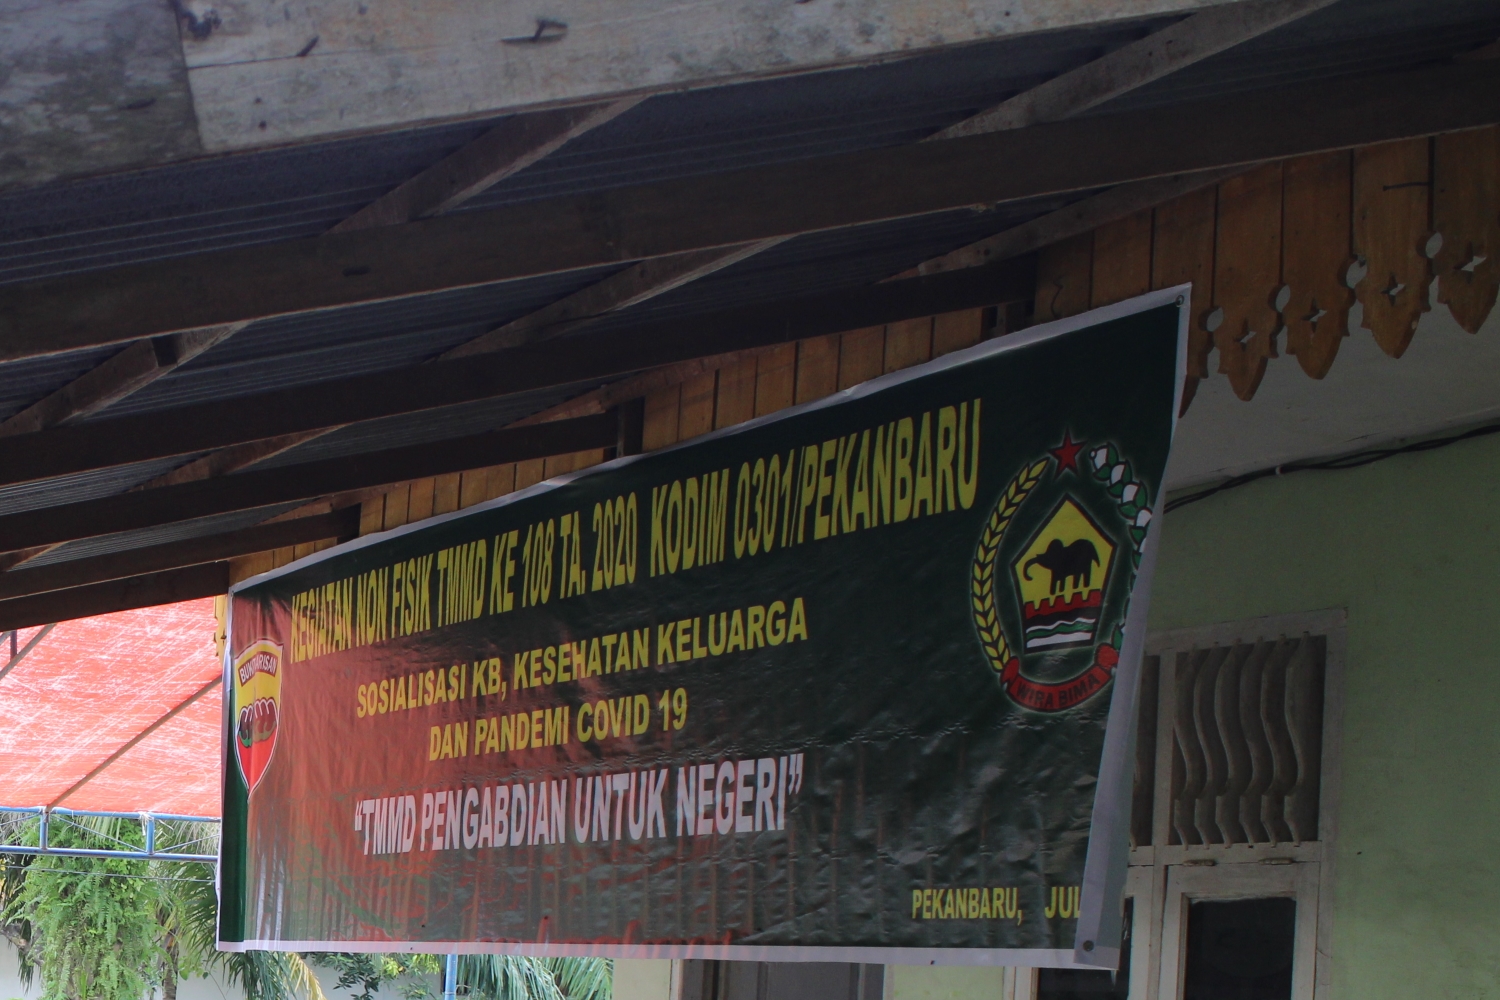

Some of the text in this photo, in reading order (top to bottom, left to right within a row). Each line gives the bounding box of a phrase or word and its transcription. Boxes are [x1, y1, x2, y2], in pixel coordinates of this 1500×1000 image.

[291, 398, 981, 664] KEGIATAN NON FISIK TMMD KE 108 TA. 2020 KODIM 0301/PEKANBARU
[357, 597, 808, 718] SOSIALISASI KB, KESEHATAN KELUARGA
[1017, 673, 1100, 709] WIRA BIMA
[429, 687, 687, 761] DAN PANDEMI COVID 19
[420, 778, 567, 852] PENGABDIAN
[575, 767, 666, 843] UNTUK
[912, 887, 1023, 926] PEKANBARU,
